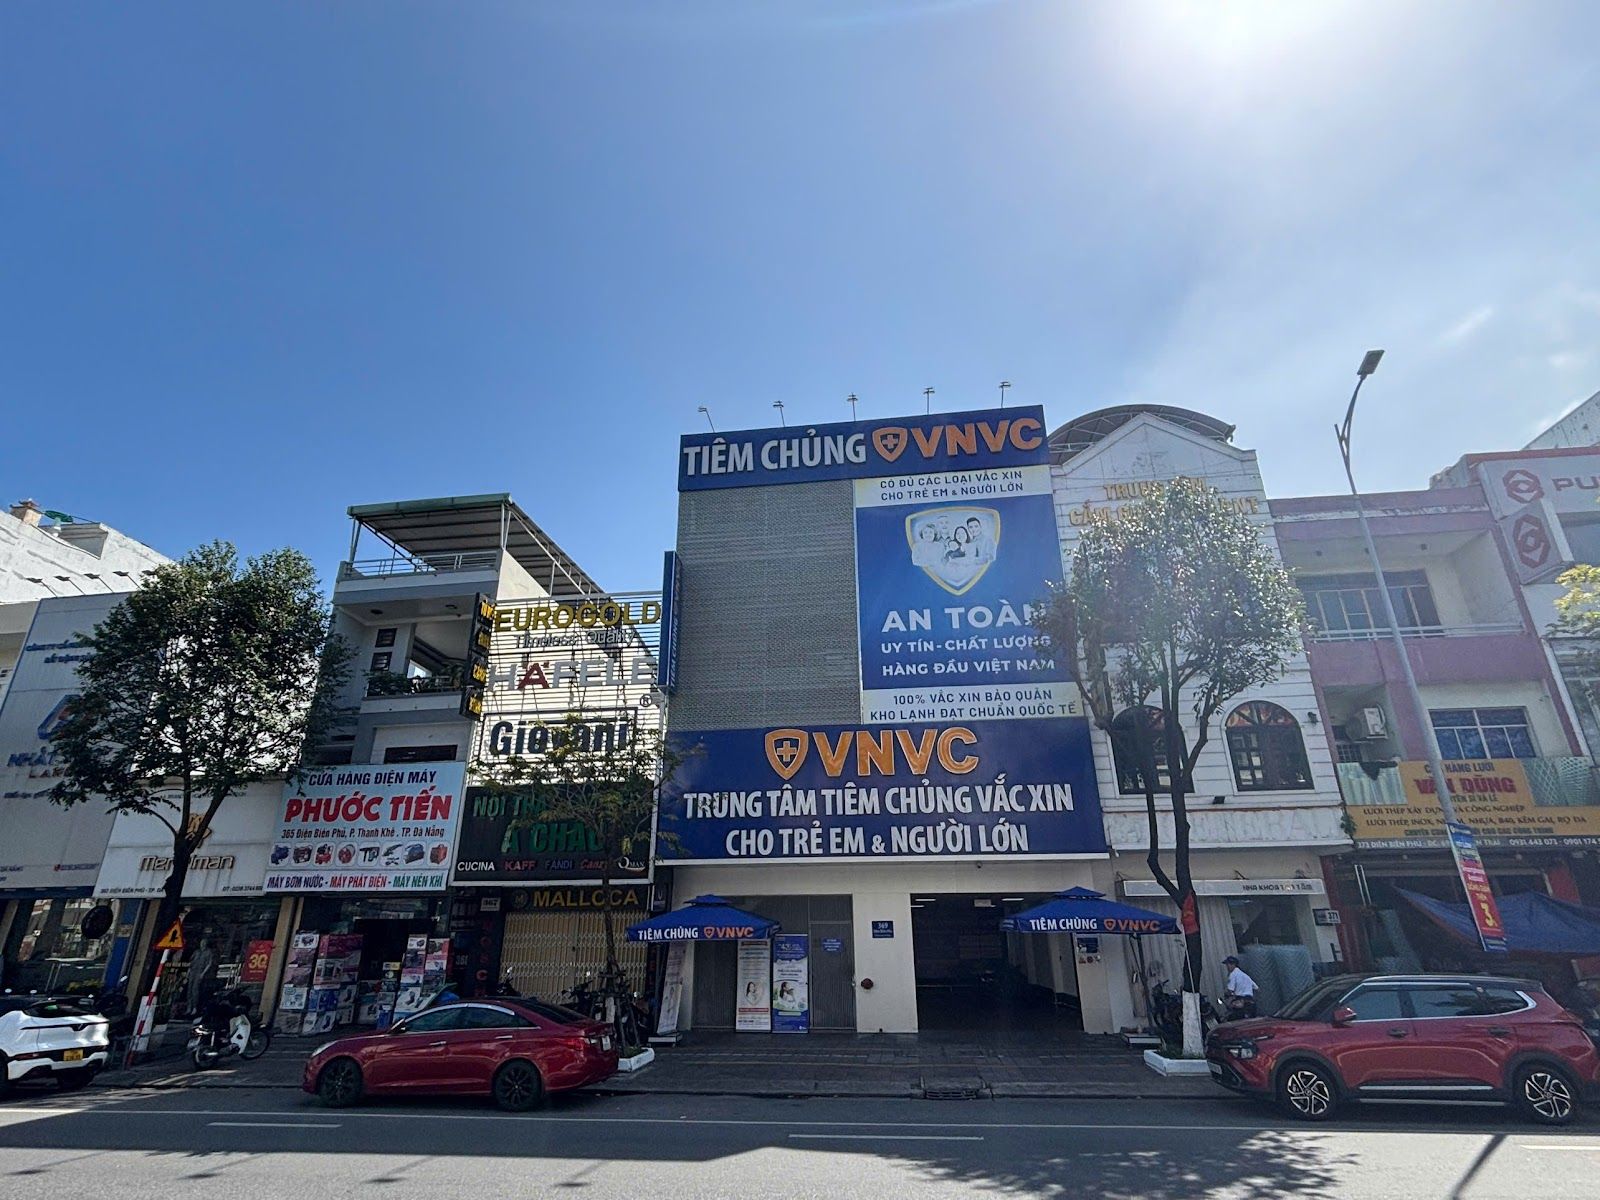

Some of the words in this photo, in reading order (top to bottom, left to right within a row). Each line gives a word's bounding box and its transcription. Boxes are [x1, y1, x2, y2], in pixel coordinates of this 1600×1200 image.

[684, 437, 754, 476] TIÊM
[761, 428, 866, 470] CHỦNG
[910, 417, 1042, 458] VNVC
[880, 477, 895, 488] CÓ
[899, 474, 914, 487] ĐỦ
[918, 474, 941, 485] CÁC
[944, 474, 972, 486] LOẠI
[1002, 470, 1022, 480] XIN
[881, 491, 903, 500] CHO
[908, 488, 928, 498] TRẺ
[933, 488, 948, 497] EM
[960, 484, 996, 495] NGƯỜI
[1000, 482, 1023, 492] LỚN
[493, 601, 662, 632] EUROGOLD
[882, 609, 932, 633] AN
[881, 642, 902, 654] UY
[994, 635, 1051, 649] LƯỢNG
[487, 658, 658, 691] HÄFELE
[883, 662, 928, 676] HÀNG
[933, 658, 968, 674] ĐẦU
[974, 658, 1010, 674] VIỆT
[1017, 659, 1055, 671] NAM
[894, 694, 925, 705] 100%
[959, 692, 980, 702] XIN
[985, 688, 1011, 702] BẢO
[1016, 687, 1052, 701] QUẢN
[870, 710, 896, 721] KHO
[900, 708, 935, 722] LẠNH
[940, 707, 964, 720] ĐẠT
[969, 703, 1013, 718] CHUẨN
[1019, 701, 1055, 716] QUỐC
[1059, 700, 1077, 714] TẾ
[812, 727, 979, 777] VNVC
[336, 771, 371, 785] HÀNG
[374, 770, 404, 787] ĐIỆN
[408, 769, 437, 784] MÁY
[1460, 774, 1516, 793] DŨNG
[284, 791, 384, 823] PHƯỚC
[389, 785, 453, 821] TIẾN
[683, 791, 762, 819] TRUNG
[766, 784, 817, 817] TÂM
[821, 782, 880, 815] TIÊM
[885, 778, 972, 814] CHỦNG
[974, 773, 1026, 812] VẮC
[1027, 783, 1074, 811] XIN
[281, 829, 294, 839] 365
[357, 828, 379, 837] Thanh
[726, 829, 774, 856] CHO
[779, 820, 823, 854] TRẺ
[830, 827, 865, 854] EM
[871, 835, 886, 853] &
[891, 818, 972, 853] NGƯỜI
[978, 818, 1029, 852] LỚN
[458, 862, 495, 871] CUCINA
[504, 860, 536, 870] KAFF
[544, 860, 573, 870] FANDI
[267, 874, 284, 888] MÁY
[285, 875, 301, 888] BƠM
[303, 874, 324, 888] NƯỚC
[330, 874, 347, 888] MÁY
[348, 874, 368, 888] PHÁT
[369, 874, 388, 890] ĐIỆN
[393, 874, 410, 887] MÁY
[412, 872, 428, 887] NÉN
[429, 872, 443, 887] KHÍ
[638, 927, 663, 940] TIÊM
[664, 925, 699, 939] CHỦNG
[716, 927, 754, 938] VNVC
[1030, 917, 1057, 931] TIÊM
[1059, 916, 1097, 930] CHỦNG
[1118, 920, 1160, 931] VNVC
